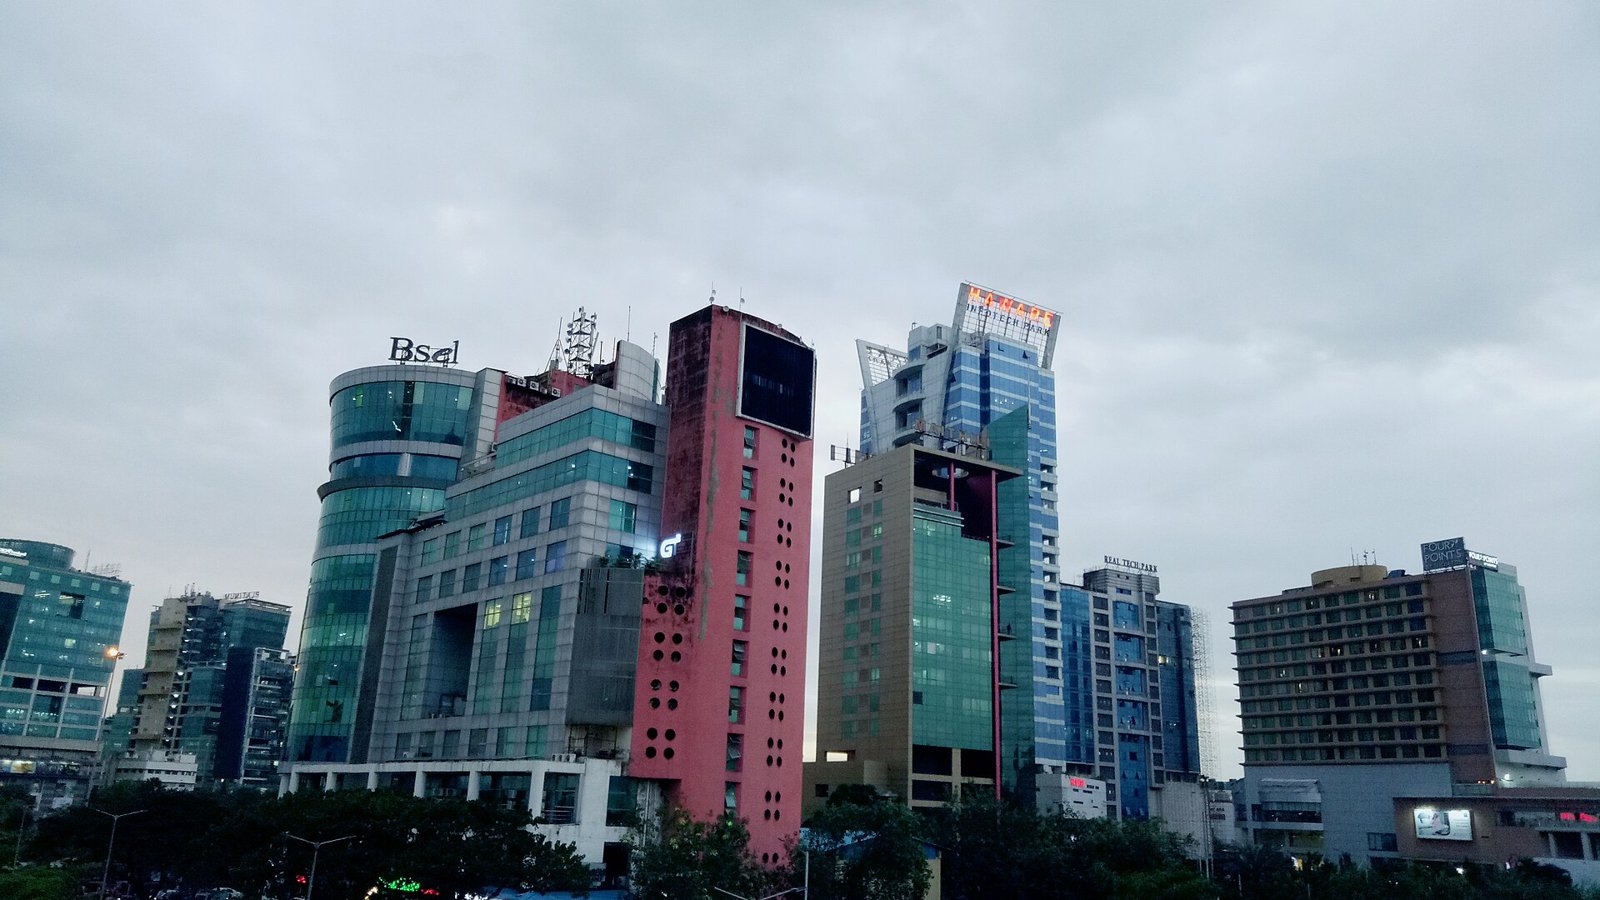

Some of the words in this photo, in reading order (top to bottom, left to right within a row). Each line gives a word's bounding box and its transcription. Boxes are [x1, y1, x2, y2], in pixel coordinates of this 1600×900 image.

[966, 303, 1019, 327] INFOTECH
[1023, 321, 1051, 337] PARK
[388, 336, 460, 364] Bsel
[1423, 541, 1450, 554] FOUR
[1424, 549, 1463, 564] POINTS
[1104, 555, 1120, 566] REAL
[1122, 558, 1139, 569] TECH
[1141, 562, 1158, 573] PARK
